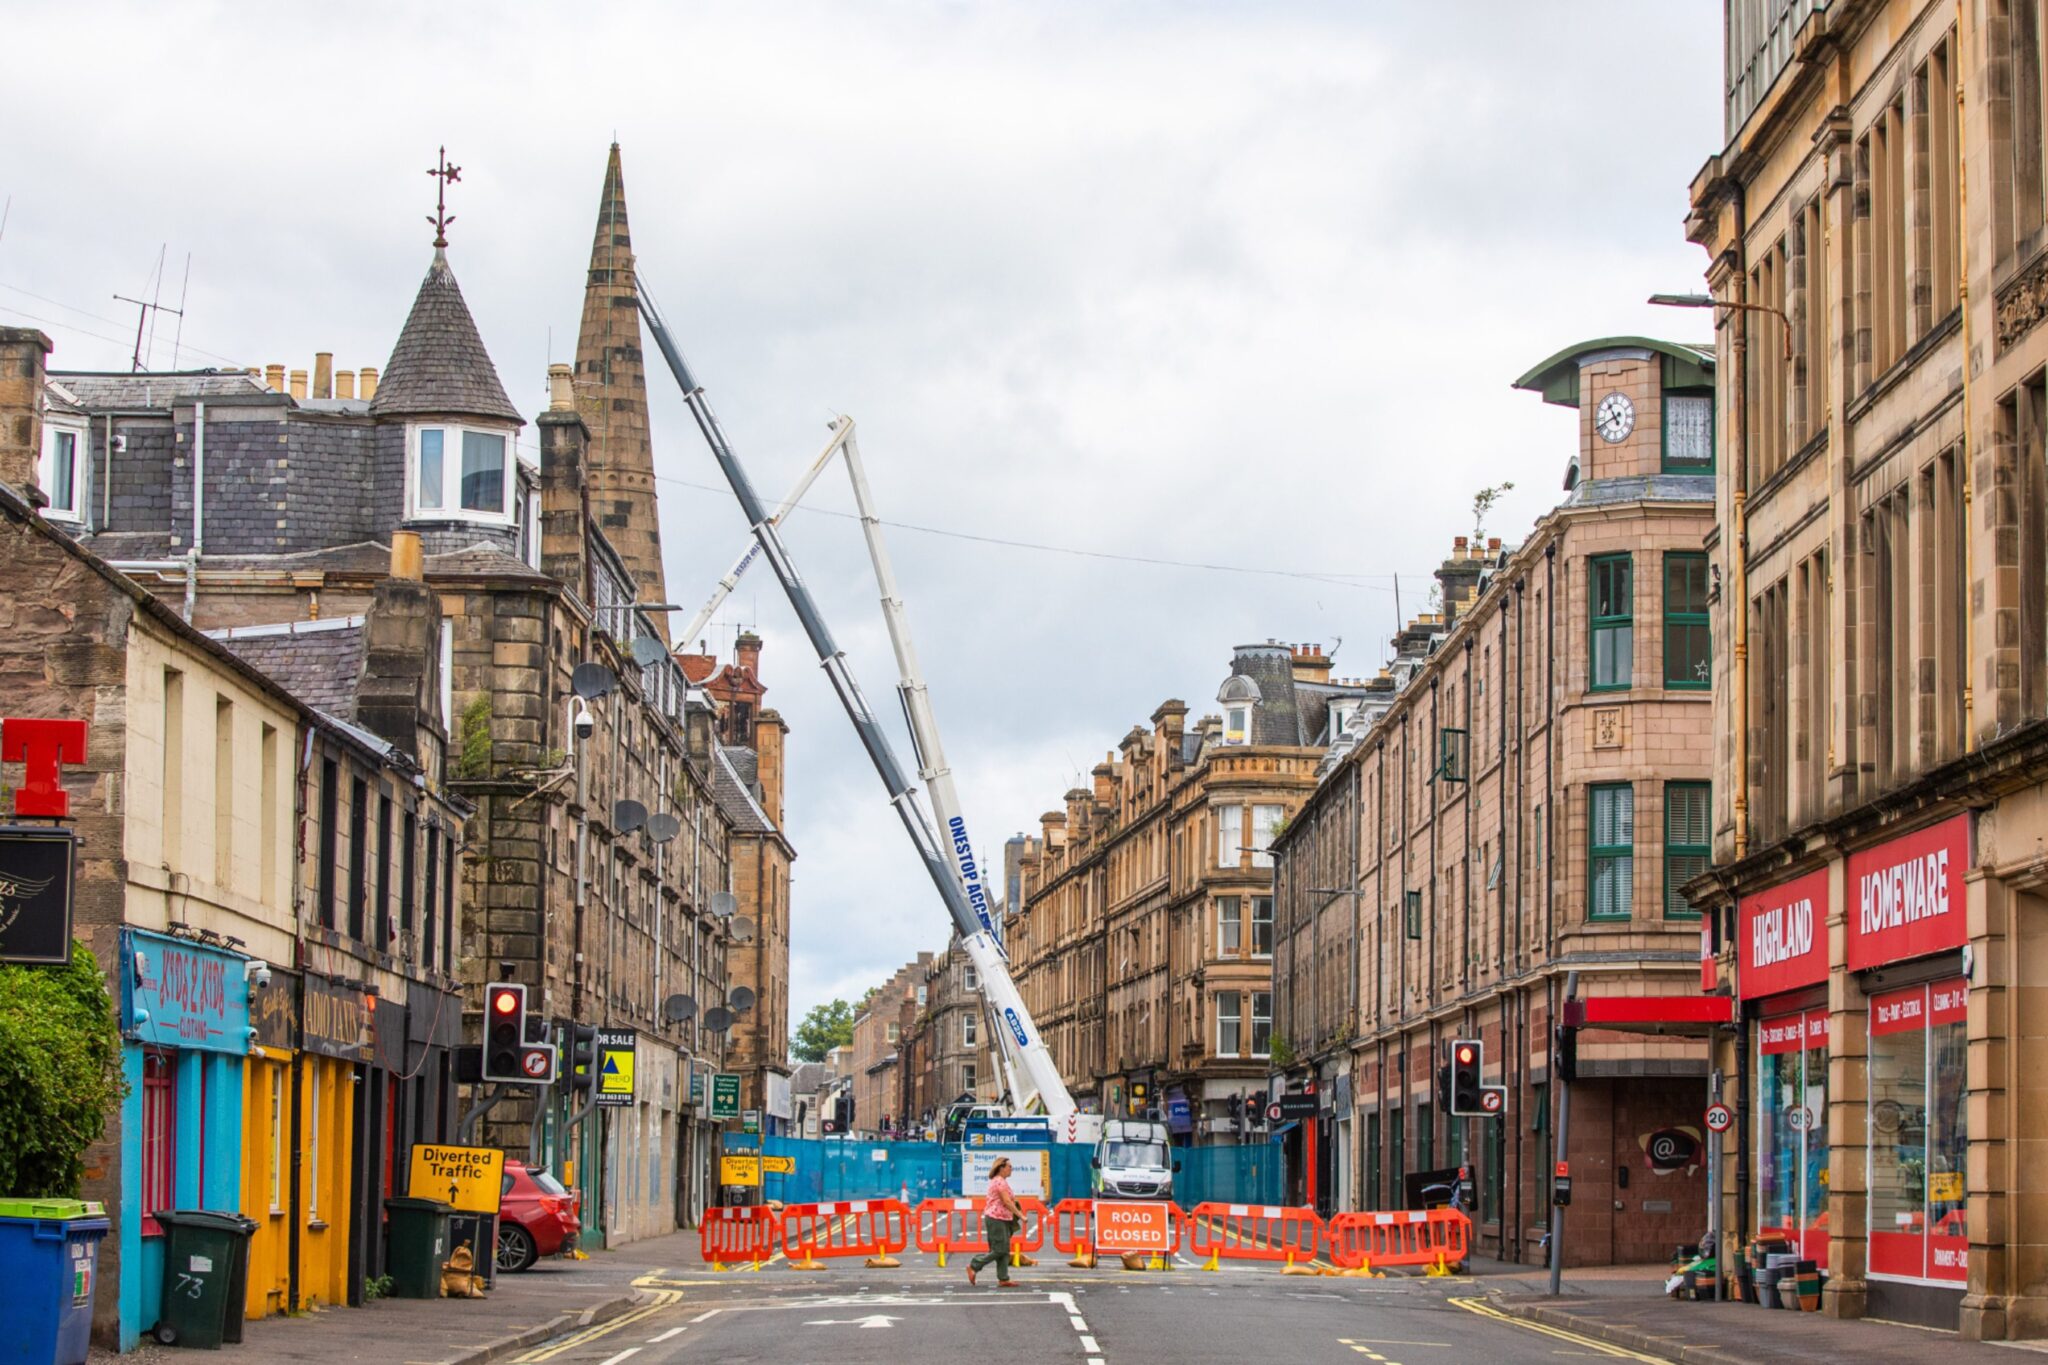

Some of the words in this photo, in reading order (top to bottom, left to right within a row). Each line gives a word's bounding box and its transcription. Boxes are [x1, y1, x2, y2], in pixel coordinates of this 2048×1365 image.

[948, 816, 978, 881] ONESTOP
[1860, 847, 1949, 935] HOMEWARE
[1752, 898, 1814, 968] HIGHLAND
[160, 948, 189, 1013] KIDS
[190, 954, 198, 1013] 2
[199, 956, 225, 1019] KIDS
[180, 1017, 207, 1041] CLOTHING
[332, 997, 358, 1045] TAXIS
[610, 1034, 634, 1045] SALE
[1708, 1112, 1727, 1124] 20
[984, 1134, 1018, 1144] Reigart
[423, 1148, 492, 1165] Diverted
[726, 1157, 758, 1165] Diverted
[430, 1163, 482, 1179] Traffic
[1112, 1212, 1152, 1224] ROAD
[1103, 1229, 1161, 1242] CLOSED
[174, 1272, 204, 1299] 73
